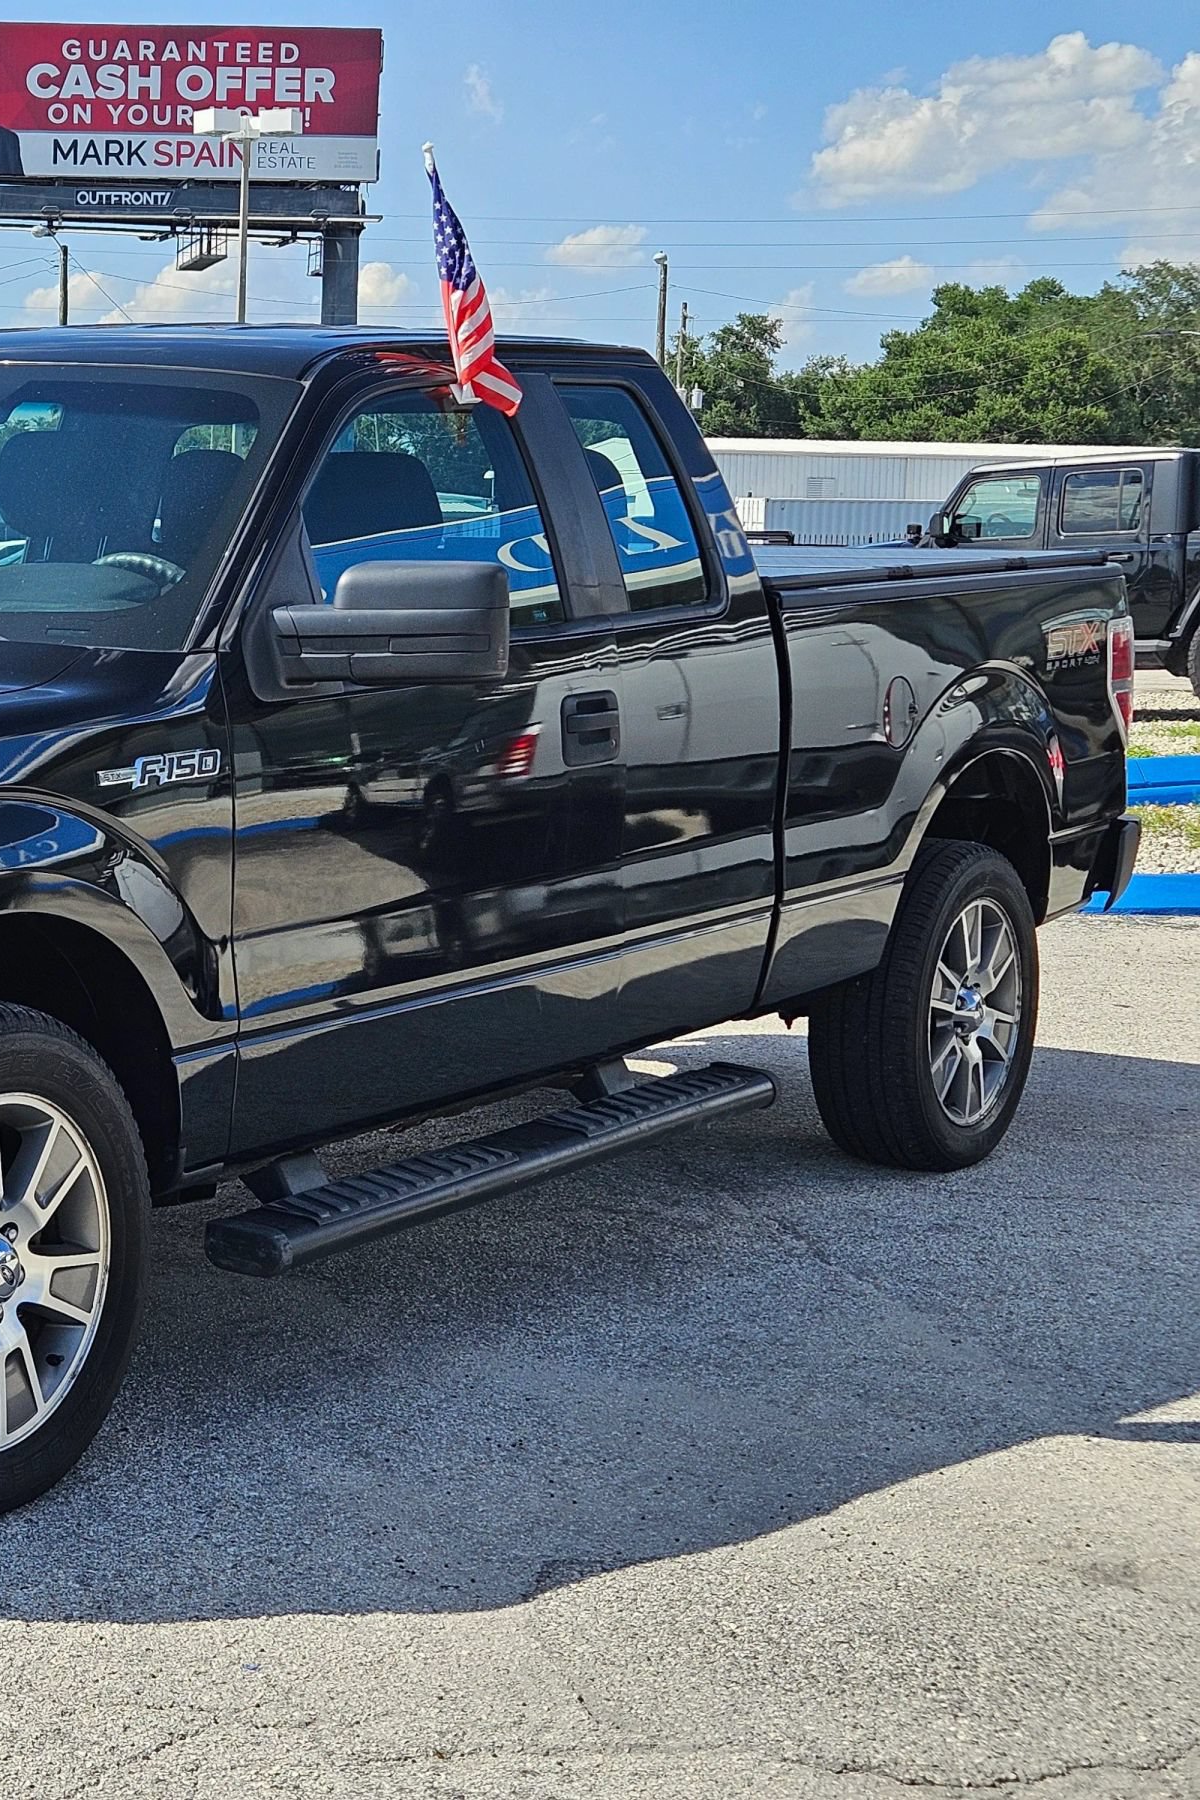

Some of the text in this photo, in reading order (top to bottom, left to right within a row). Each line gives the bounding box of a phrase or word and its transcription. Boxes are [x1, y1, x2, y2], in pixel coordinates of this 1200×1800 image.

[61, 39, 300, 64] GUARANTEED
[25, 62, 336, 103] CASH OFFER
[47, 103, 92, 125] ON
[106, 104, 194, 126] YOUR
[52, 138, 251, 168] MARK SPAIN
[257, 141, 300, 155] REAL
[257, 156, 316, 169] ESTATE
[1047, 621, 1099, 660] STX
[103, 772, 123, 782] STX
[133, 750, 221, 788] F-150
